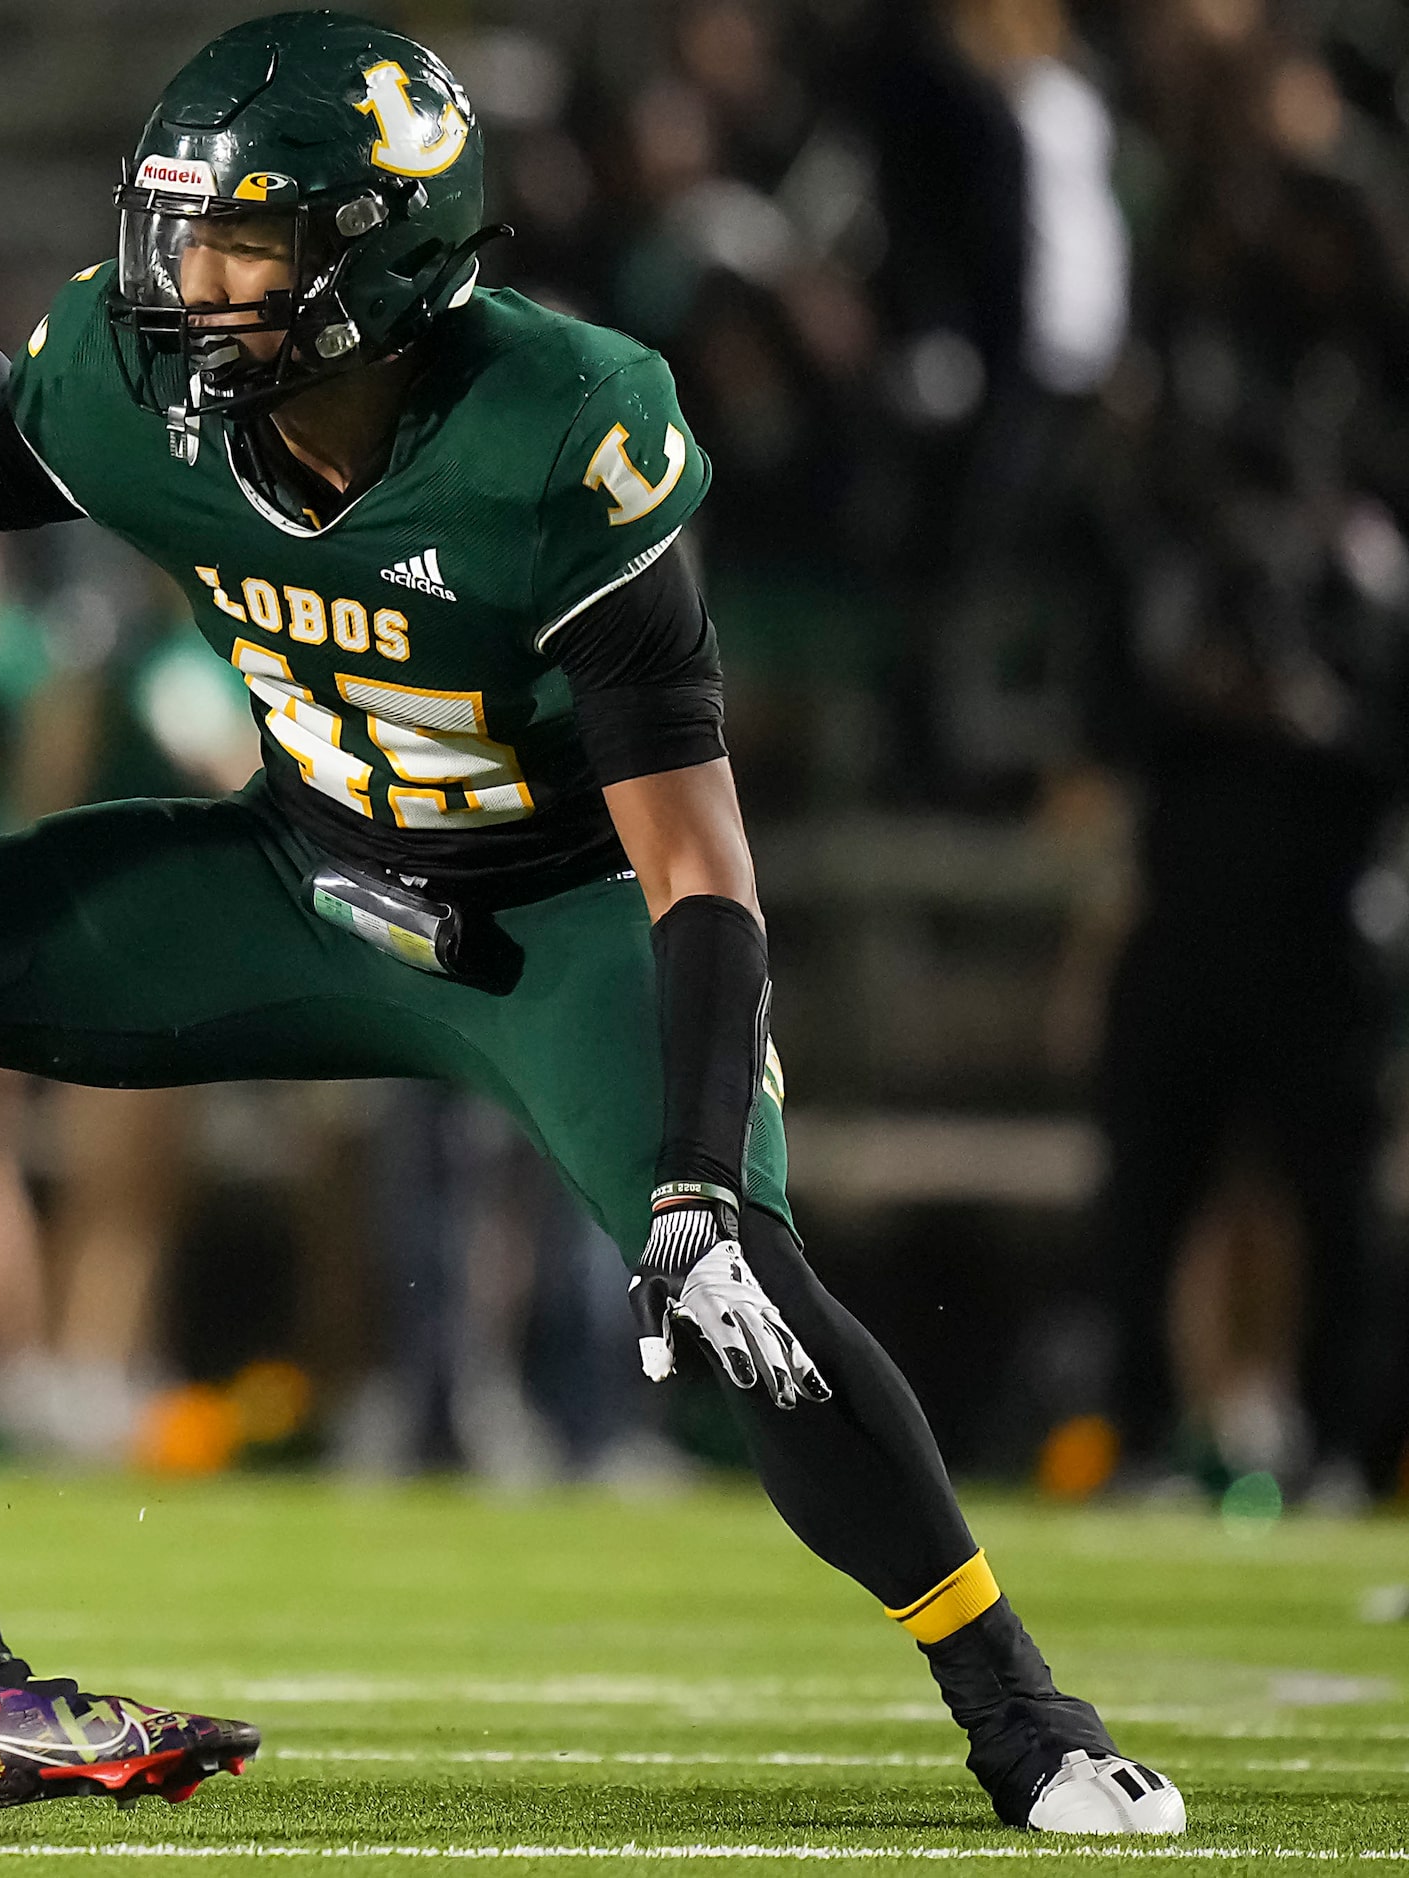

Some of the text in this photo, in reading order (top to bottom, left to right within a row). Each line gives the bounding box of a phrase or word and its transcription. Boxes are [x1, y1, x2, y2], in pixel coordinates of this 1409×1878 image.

[352, 59, 469, 178] L
[582, 421, 686, 527] L
[195, 566, 410, 662] LOBOS
[380, 569, 457, 602] adidas
[232, 637, 535, 829] 45
